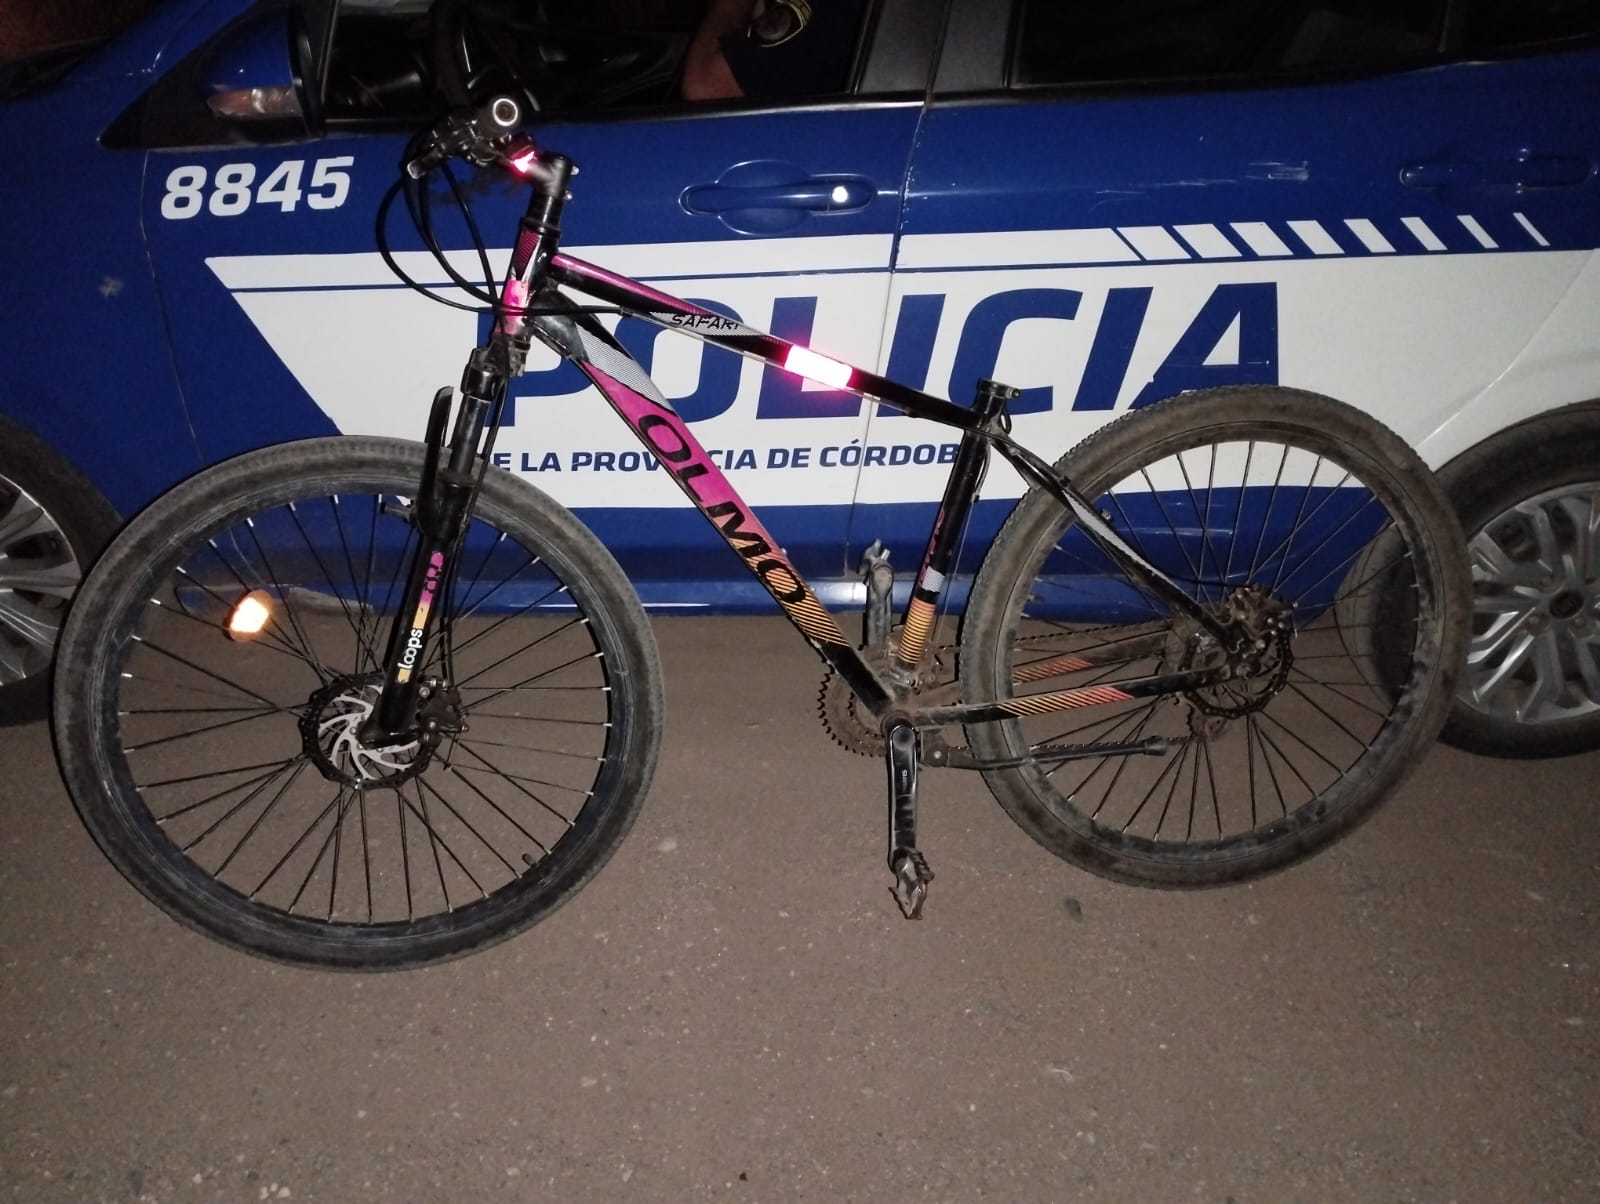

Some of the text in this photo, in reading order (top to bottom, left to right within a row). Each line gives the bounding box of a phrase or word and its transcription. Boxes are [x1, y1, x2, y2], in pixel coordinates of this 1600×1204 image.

[160, 156, 355, 220] 8845
[492, 452, 511, 472] E
[520, 452, 562, 472] LA
[766, 447, 812, 469] DE
[819, 438, 961, 468] CÓRDOB
[638, 414, 806, 604] OLMO
[397, 628, 423, 669] loops
